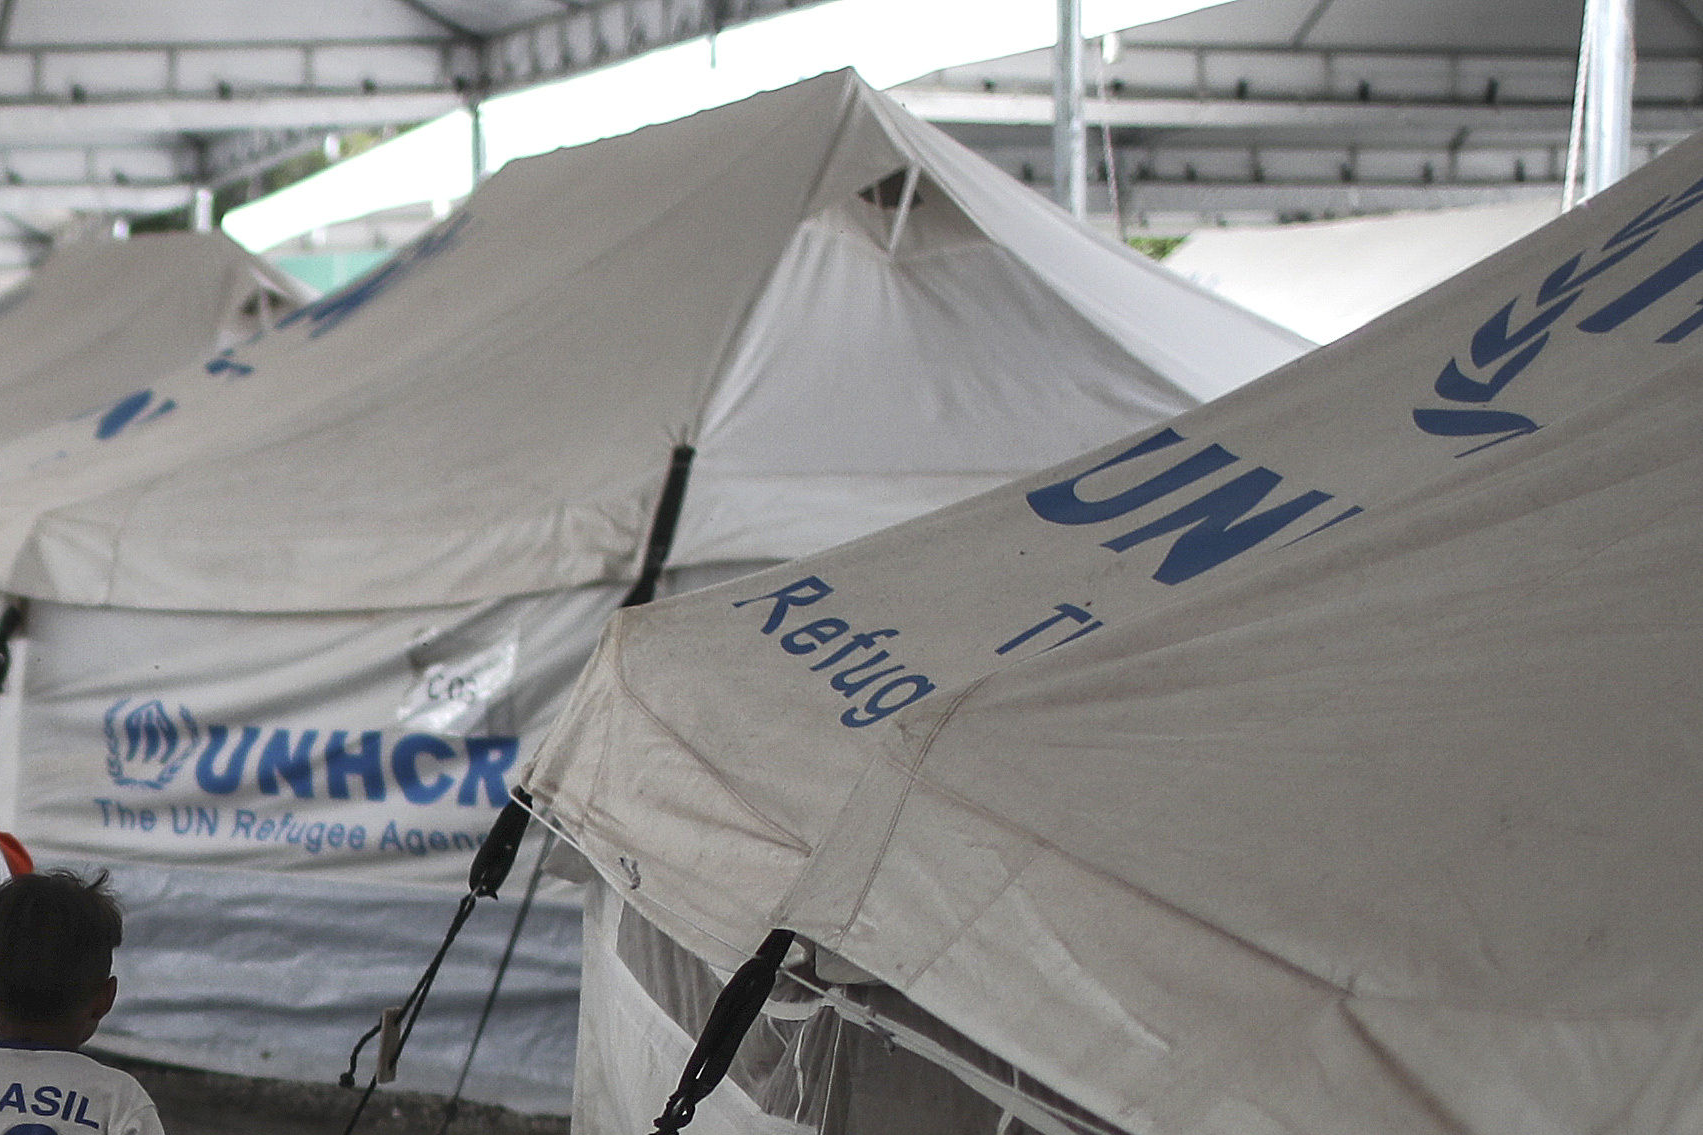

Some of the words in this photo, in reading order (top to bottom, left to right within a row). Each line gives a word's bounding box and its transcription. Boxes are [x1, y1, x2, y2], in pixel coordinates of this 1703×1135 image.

[1025, 427, 1365, 586] UN
[195, 725, 520, 808] UNHCR
[94, 798, 158, 833] The
[171, 804, 219, 839] UN
[230, 810, 367, 853] Refugee
